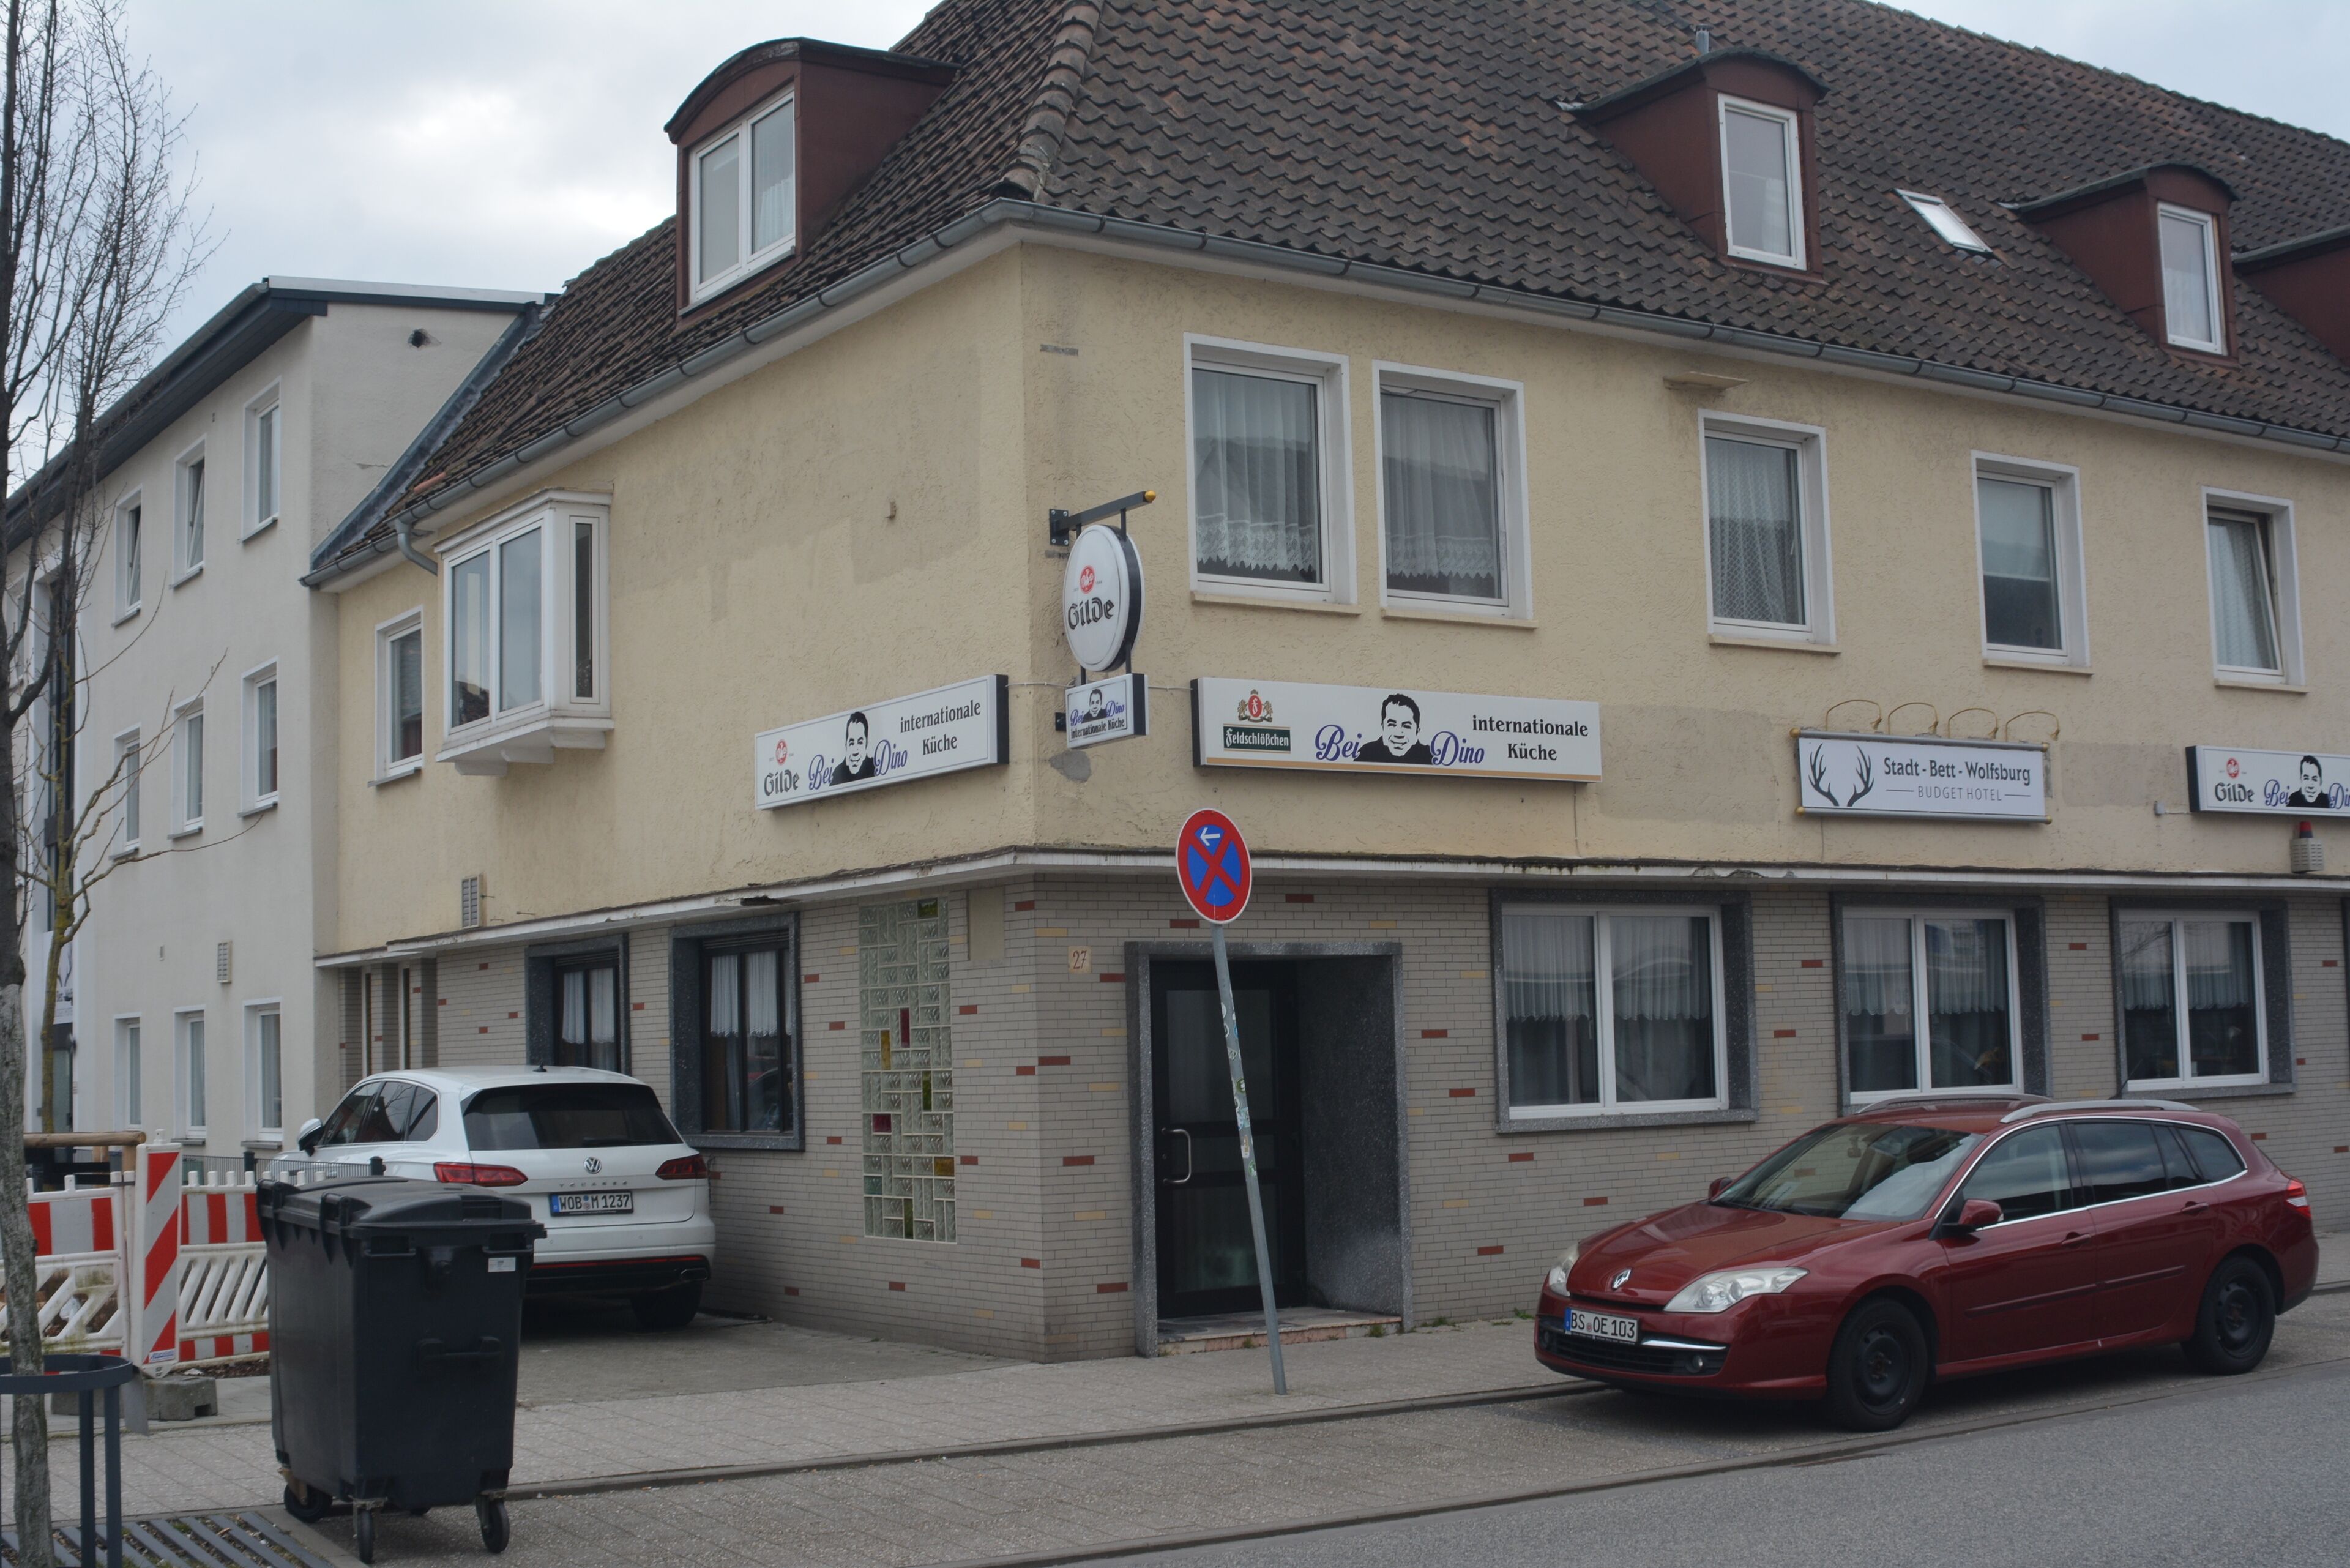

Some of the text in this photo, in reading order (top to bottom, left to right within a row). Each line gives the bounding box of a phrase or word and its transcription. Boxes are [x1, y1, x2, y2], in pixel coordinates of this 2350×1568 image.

[1068, 597, 1114, 630] Gilde
[900, 700, 981, 733] internationale
[1070, 700, 1125, 726] Bei Dino
[1071, 717, 1125, 739] internationale Küche
[1225, 727, 1289, 747] Feldschlößchen
[1472, 714, 1589, 737] internationale
[923, 734, 957, 756] Küche
[1315, 724, 1485, 766] Bei Dino
[1507, 742, 1557, 761] Küche
[808, 739, 908, 790] Bei Dino
[1884, 757, 1920, 777] Stadt
[1930, 760, 1956, 778] Bett
[1964, 761, 2031, 786] Wolfsburg
[764, 769, 800, 796] Gilde
[1918, 785, 2002, 801] BUDGET HOTEL
[2214, 782, 2255, 802] Gilde
[2264, 778, 2350, 810] Bei Di
[1072, 950, 1087, 969] 27
[559, 1196, 582, 1211] WOB
[591, 1195, 599, 1209] M
[602, 1194, 630, 1209] 1237
[1571, 1312, 1635, 1339] BS OE 103
